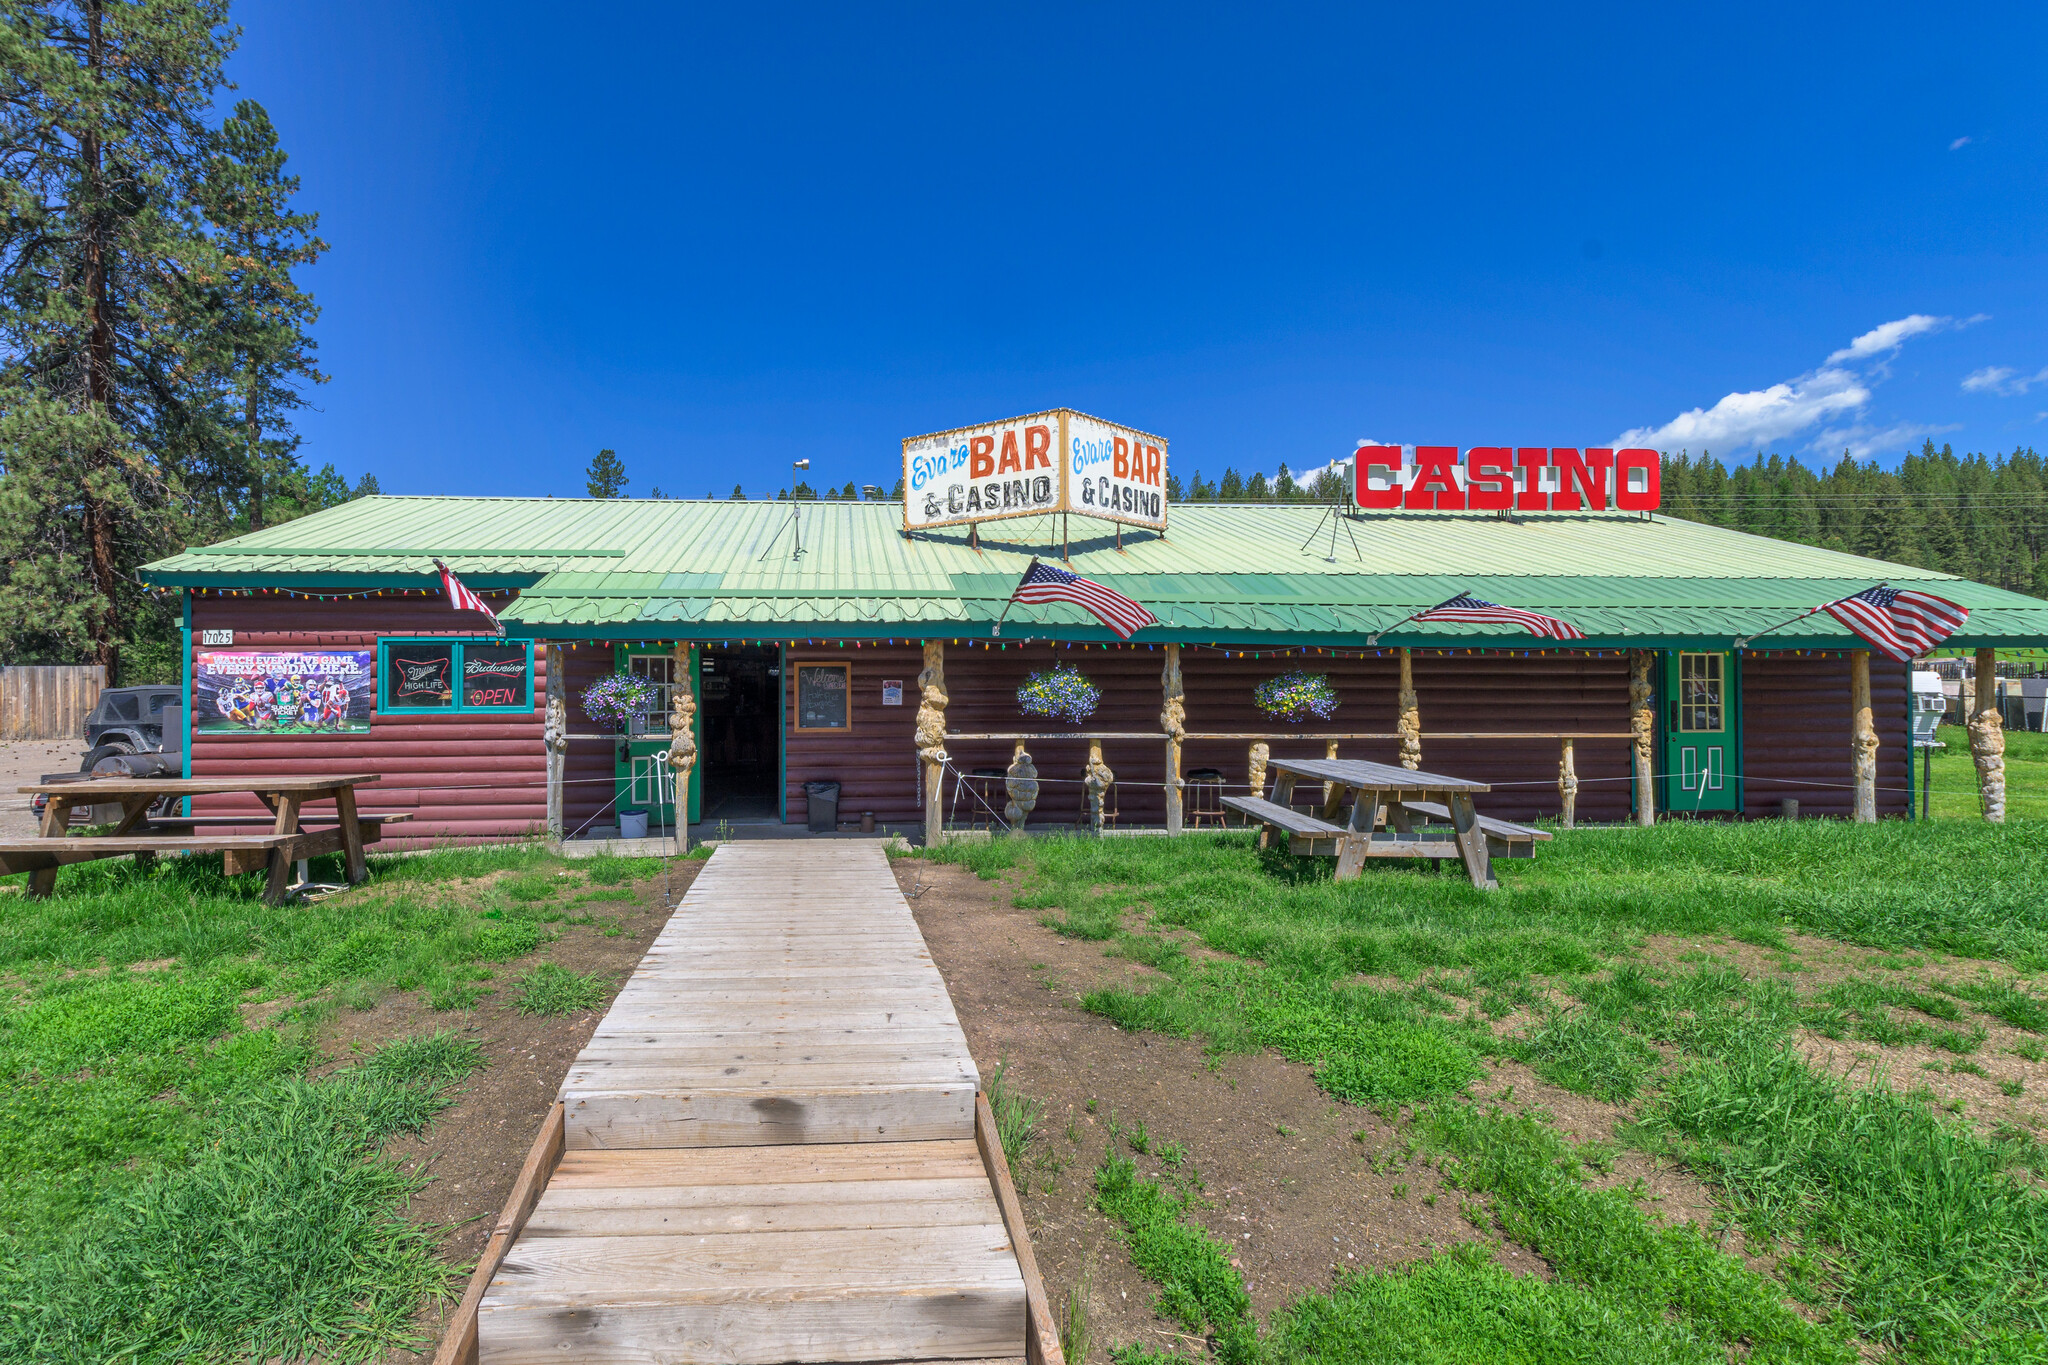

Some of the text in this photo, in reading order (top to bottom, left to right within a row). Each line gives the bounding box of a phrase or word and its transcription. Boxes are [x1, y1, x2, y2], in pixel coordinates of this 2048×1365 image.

[912, 424, 1052, 491] Evaro BAR
[1073, 436, 1161, 487] Evaro BAR
[1352, 445, 1661, 511] CASINO
[925, 476, 1050, 518] & CASINO
[1082, 476, 1160, 518] & CASINO
[204, 632, 231, 644] 17025
[213, 655, 357, 665] WATCH EVERY LIVE GAME.
[463, 659, 527, 674] Budweiser
[206, 663, 363, 675] EVERY SUNDAY HERE.
[408, 665, 438, 679] Miller
[404, 680, 443, 690] HIGH LIFE
[472, 688, 516, 706] OPEN
